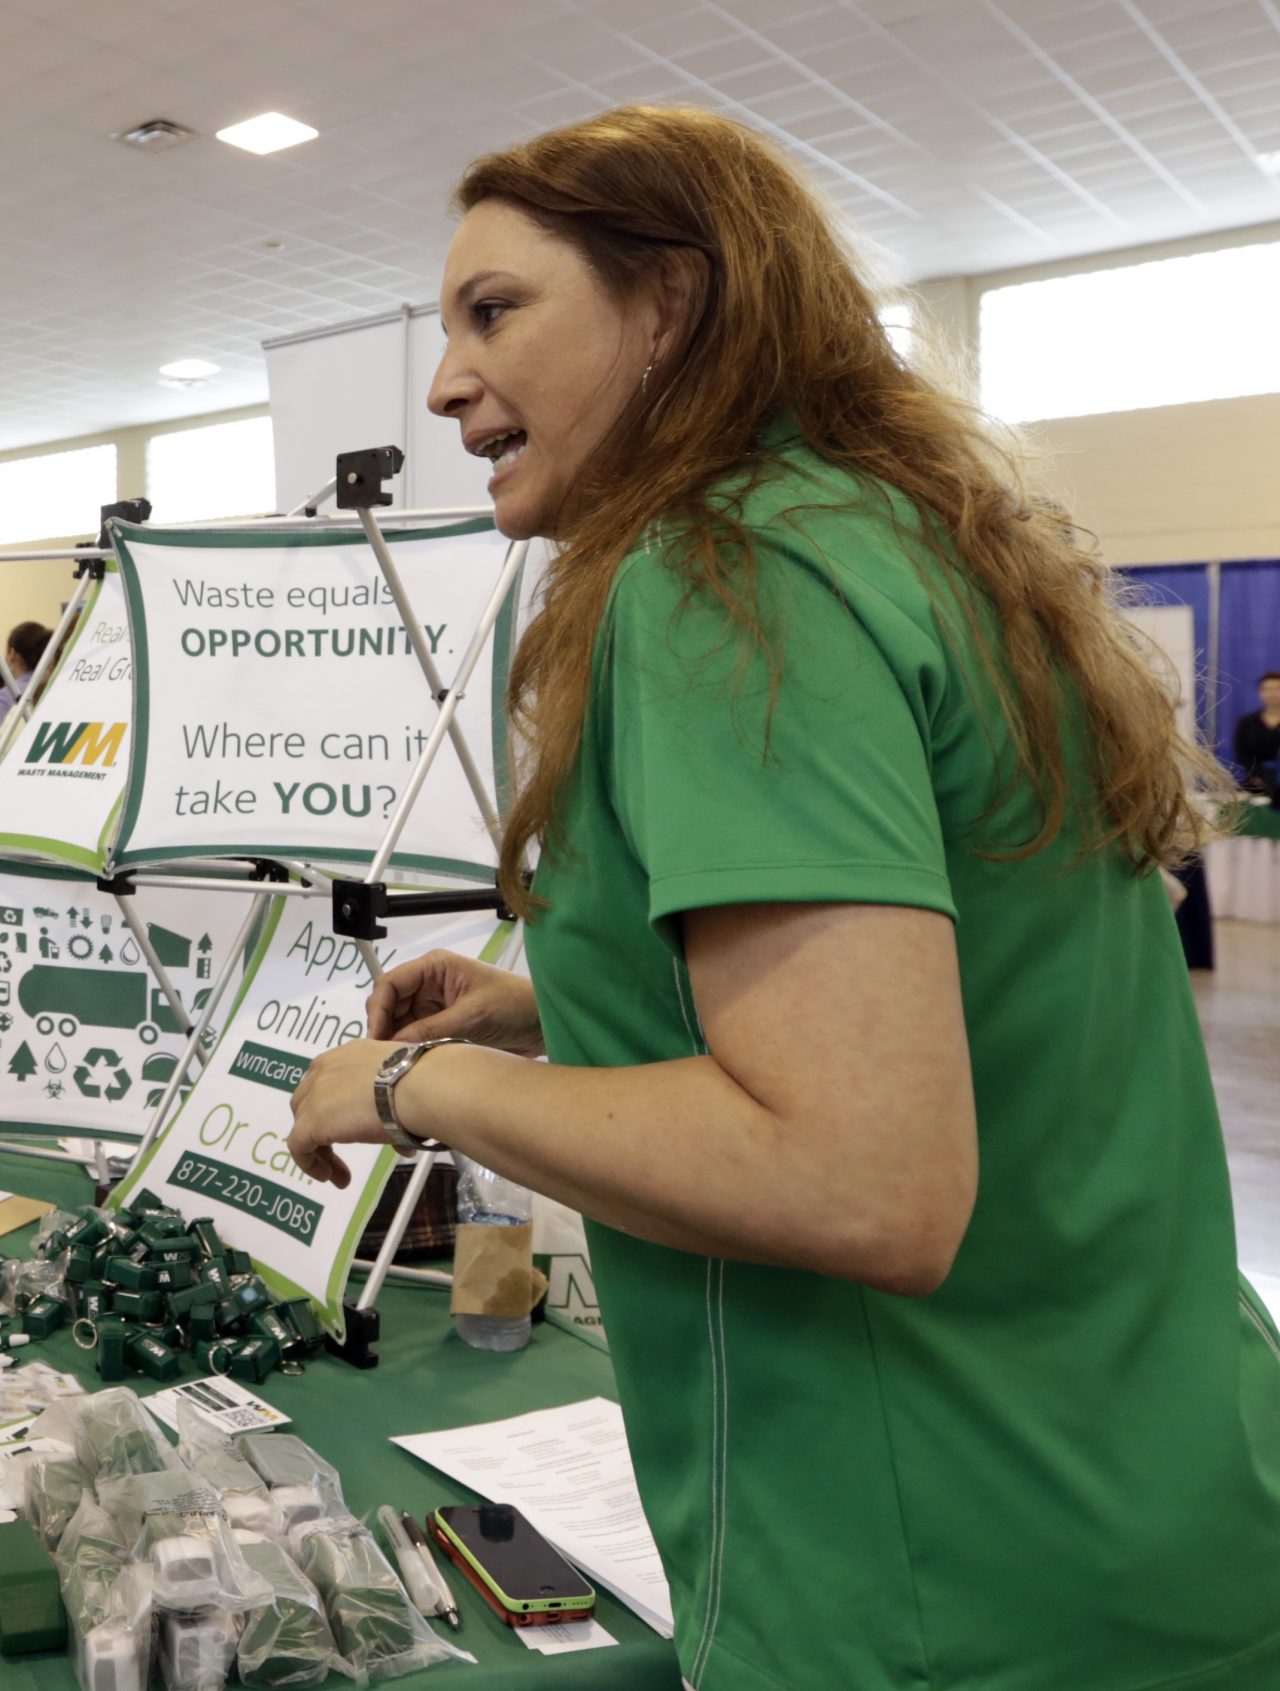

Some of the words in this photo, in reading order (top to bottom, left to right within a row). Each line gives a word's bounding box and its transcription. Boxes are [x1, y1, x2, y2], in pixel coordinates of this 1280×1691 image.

[173, 578, 275, 608] Waste
[287, 576, 396, 615] equals
[69, 657, 111, 682] Real
[24, 721, 128, 767] WM
[182, 722, 306, 759] Where
[320, 733, 389, 760] can
[405, 726, 429, 762] it
[17, 768, 47, 777] WASTE
[47, 769, 108, 781] MANAGEMENT
[175, 780, 257, 816] take
[273, 782, 397, 819] YOU?
[199, 1103, 250, 1152] Or
[176, 1159, 316, 1235] 877-220-JOBS
